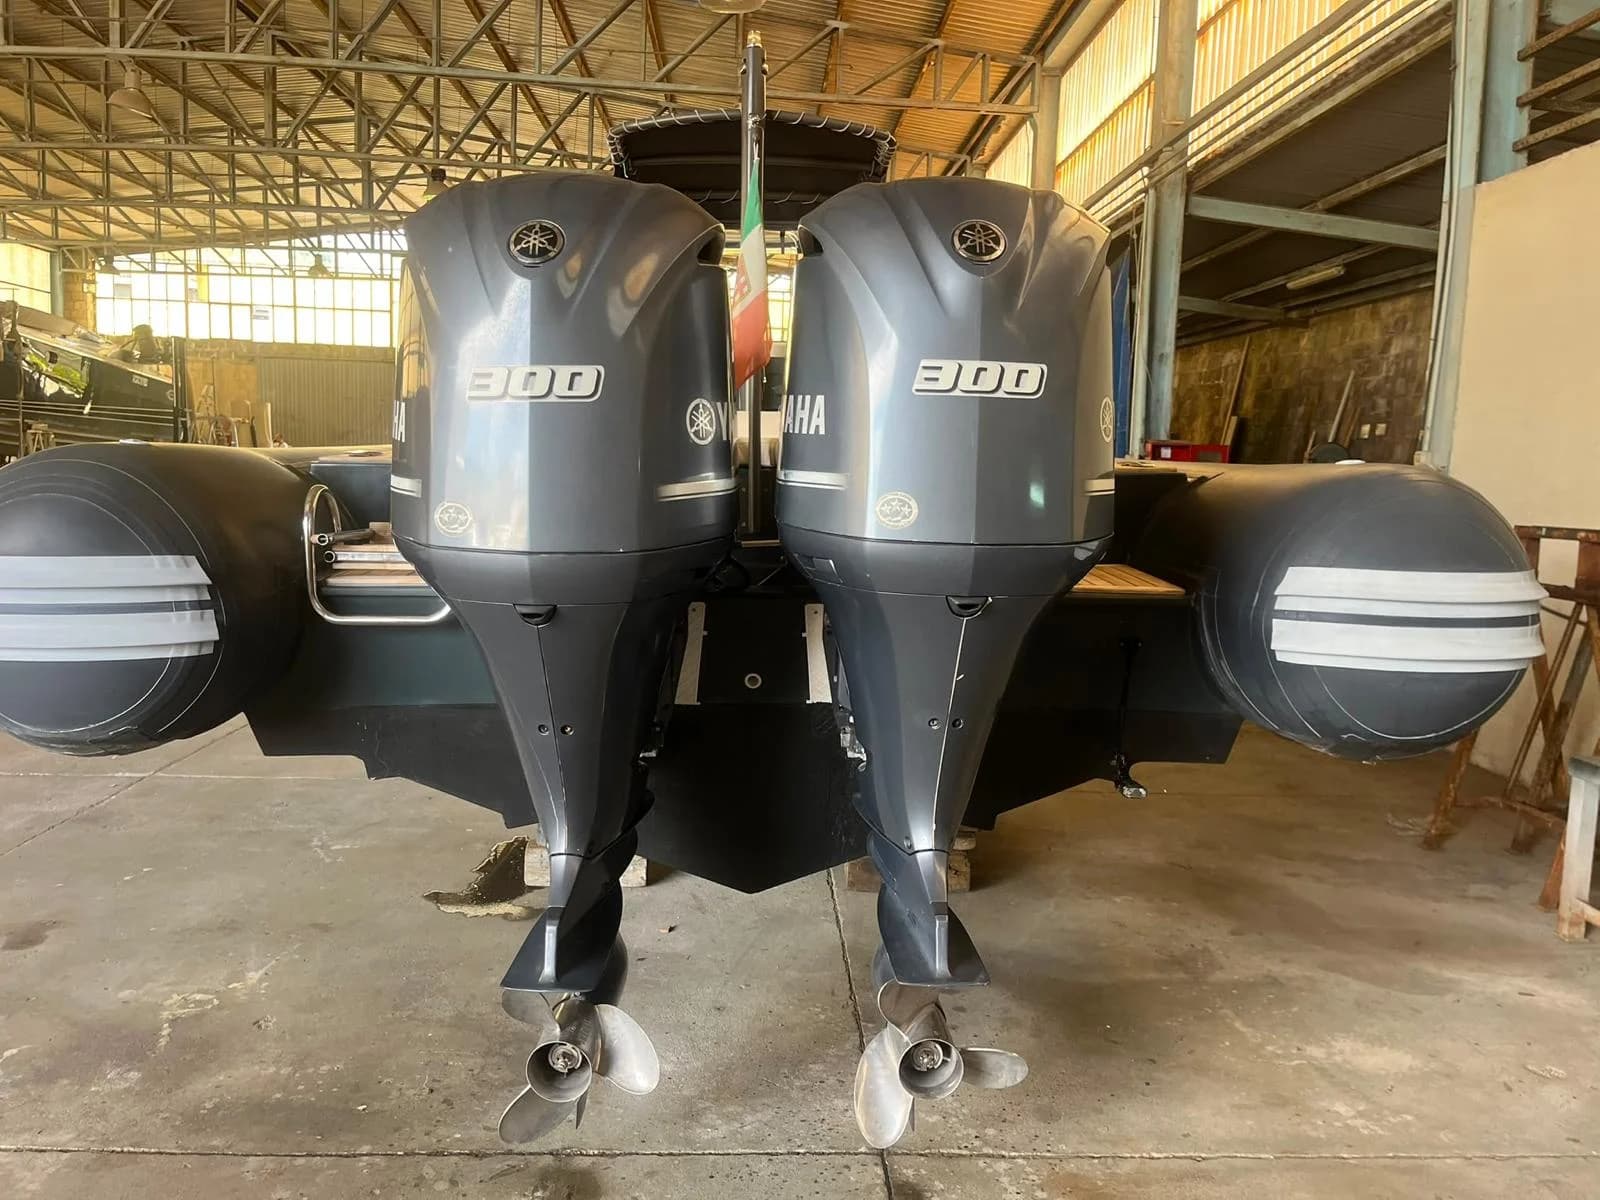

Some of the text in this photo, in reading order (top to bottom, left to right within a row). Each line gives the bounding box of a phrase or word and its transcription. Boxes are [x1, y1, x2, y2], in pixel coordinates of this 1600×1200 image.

[466, 365, 604, 402] 300
[912, 359, 1047, 398] 300
[783, 394, 825, 435] AHA
